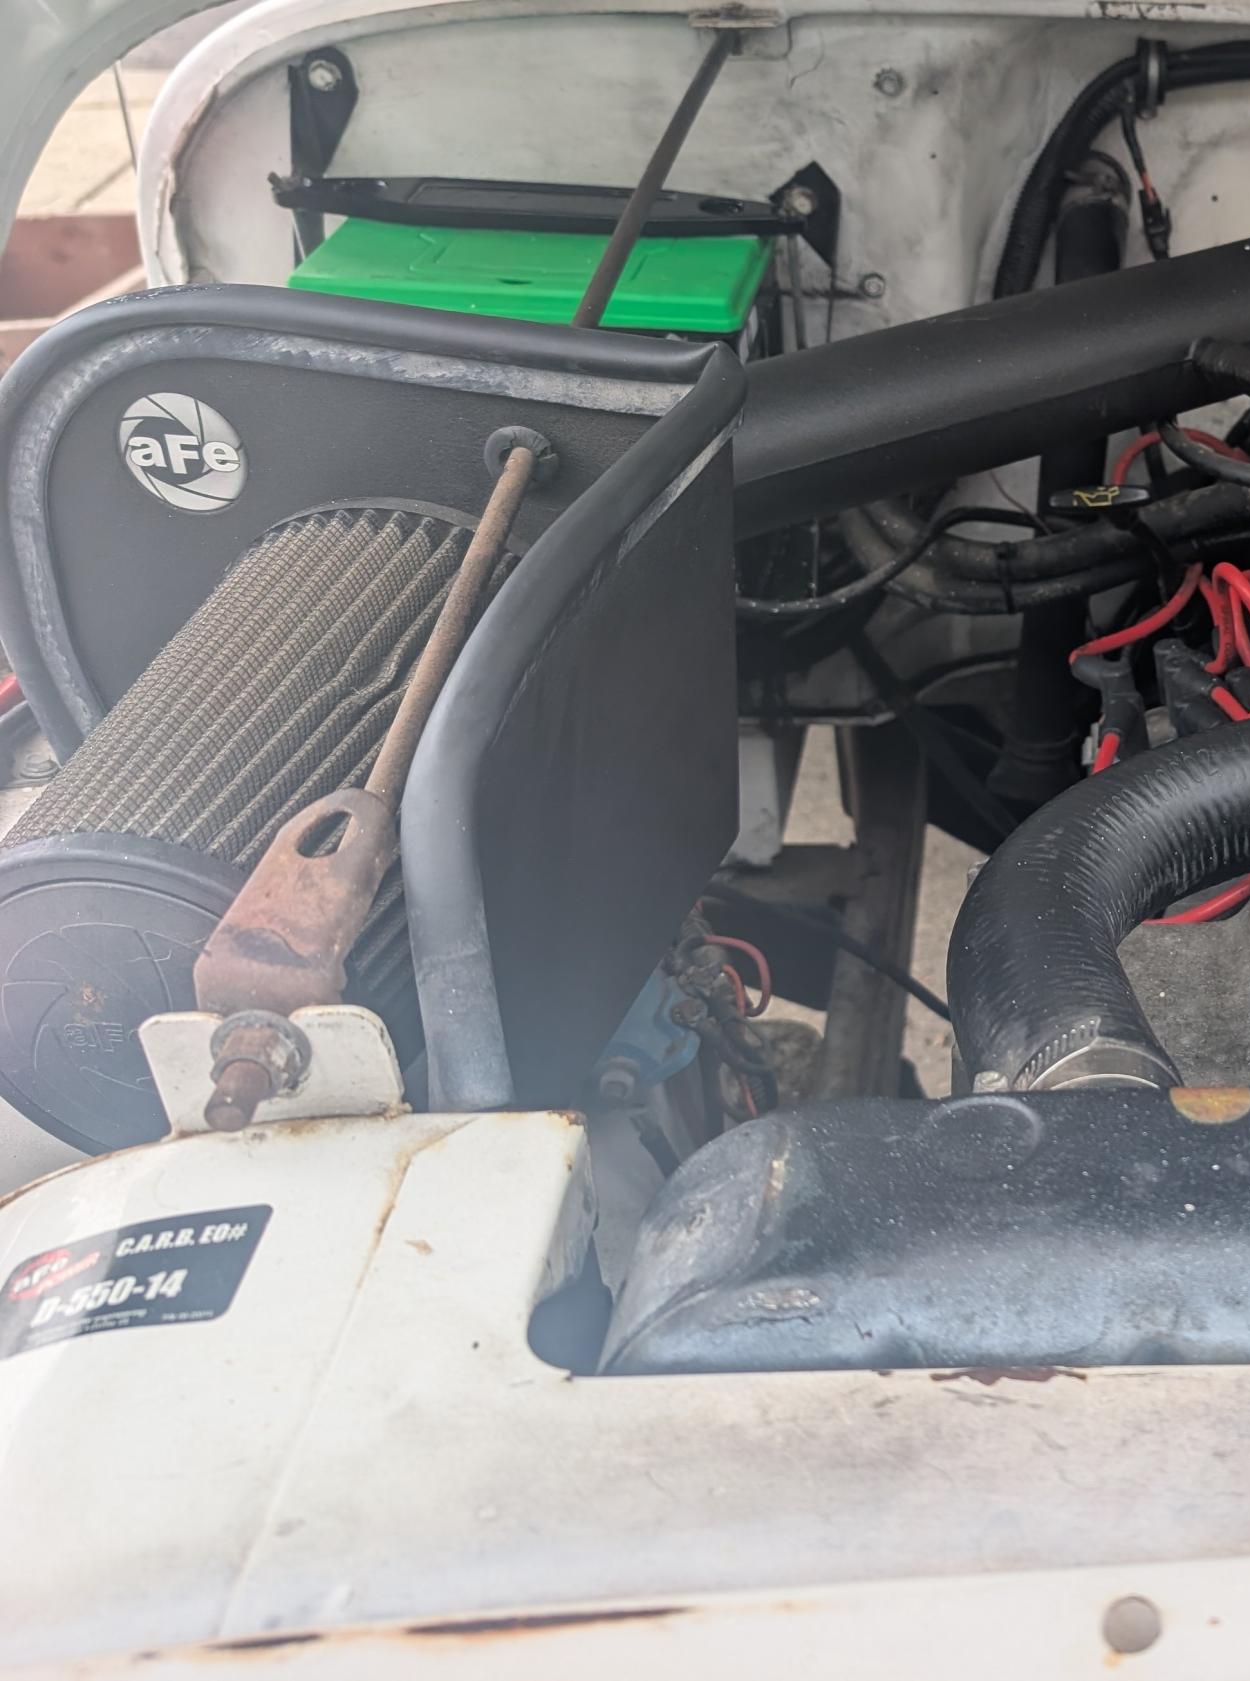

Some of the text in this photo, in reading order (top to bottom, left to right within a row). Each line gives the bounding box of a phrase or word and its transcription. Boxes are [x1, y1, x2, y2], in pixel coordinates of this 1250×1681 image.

[127, 433, 241, 474] aFe
[115, 1222, 248, 1258] C.A.R.B. EO#
[30, 1269, 189, 1328] D-550-14
